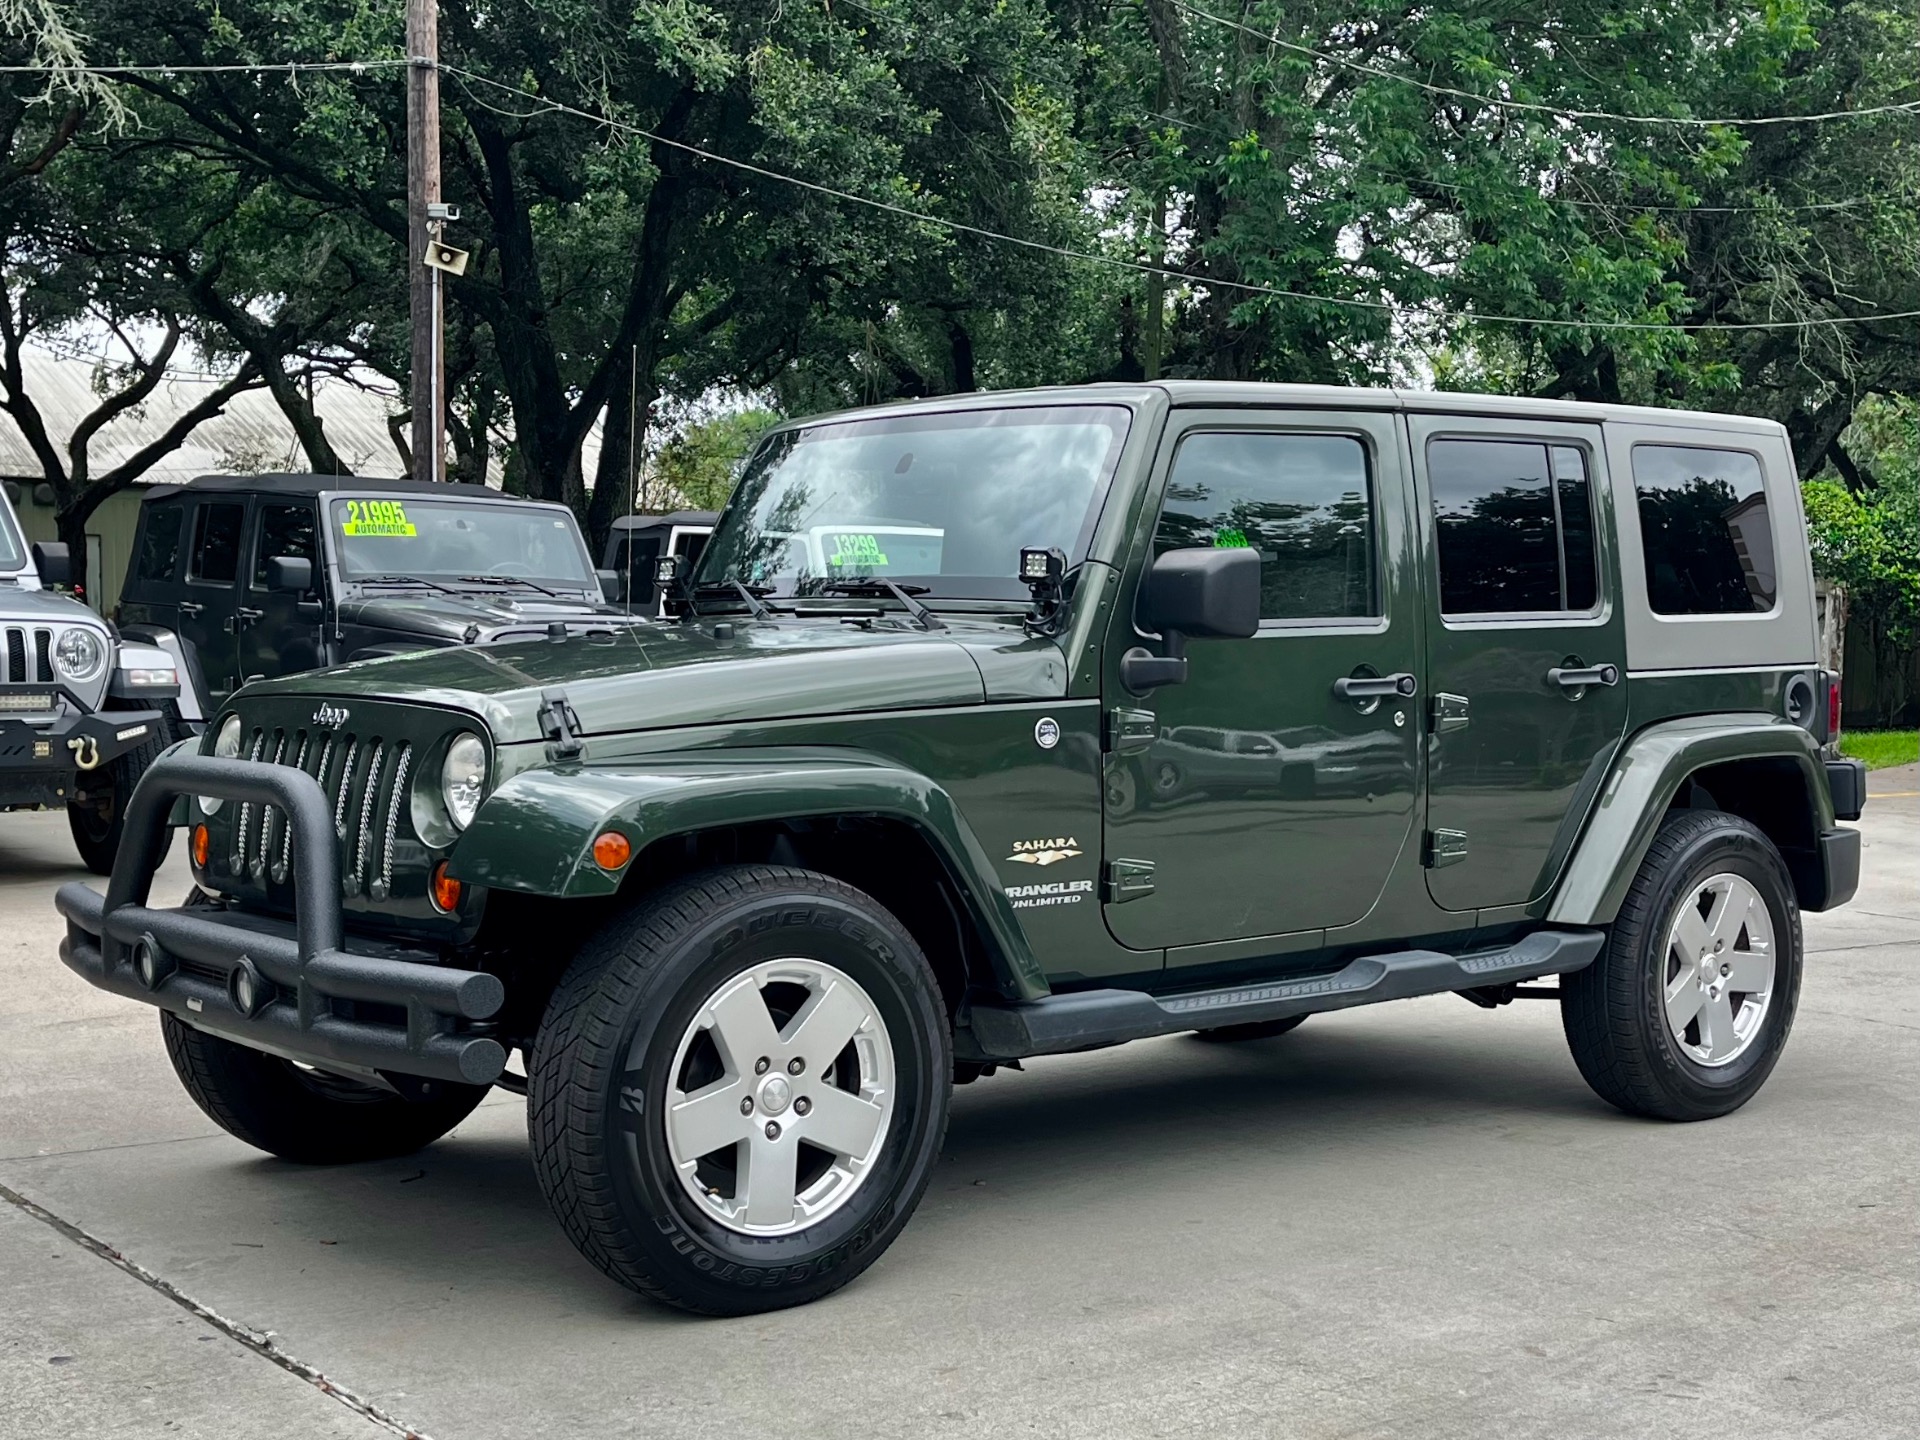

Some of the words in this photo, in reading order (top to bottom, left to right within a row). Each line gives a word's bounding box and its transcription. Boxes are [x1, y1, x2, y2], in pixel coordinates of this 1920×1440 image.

[347, 501, 406, 524] 21995
[355, 524, 406, 534] AUTOMATIC
[833, 535, 879, 555] 13299
[312, 702, 349, 730] Jeep
[1012, 837, 1077, 851] SAHARA
[711, 909, 896, 964] DUELER
